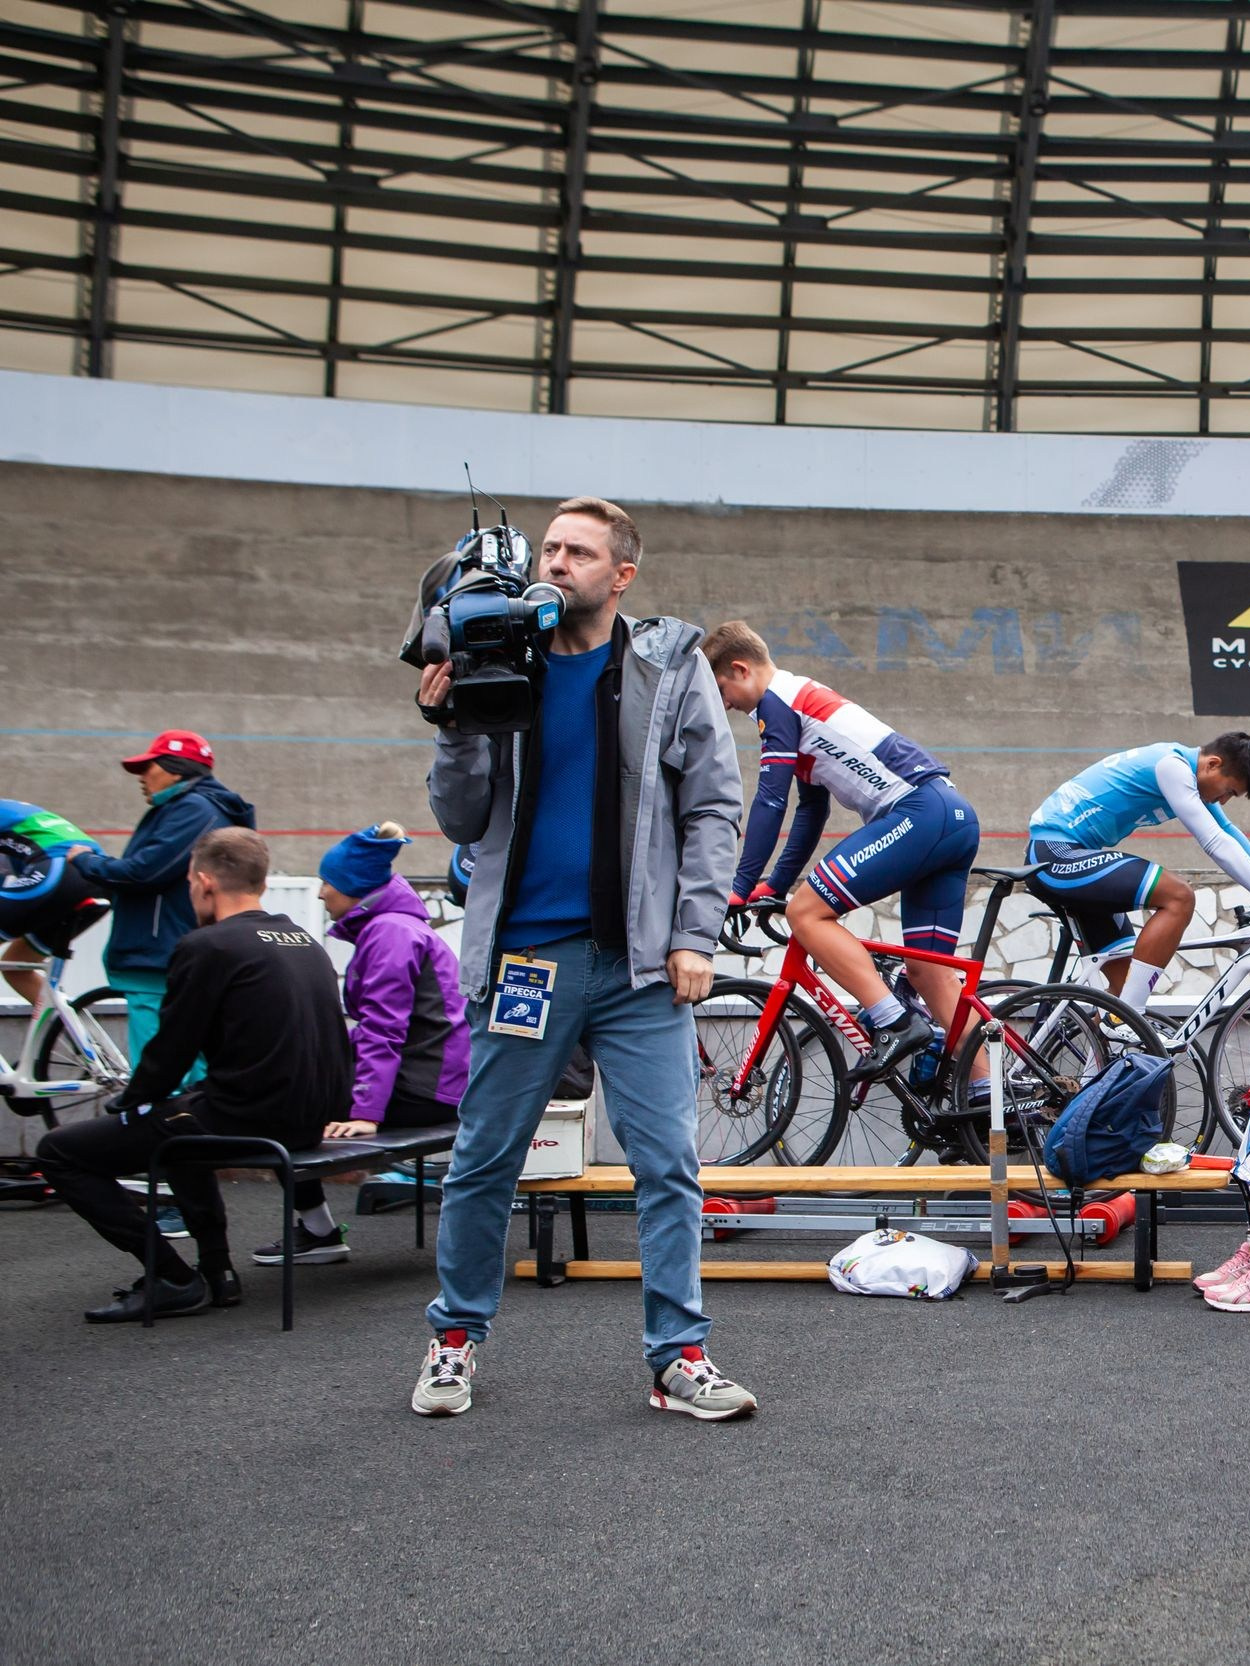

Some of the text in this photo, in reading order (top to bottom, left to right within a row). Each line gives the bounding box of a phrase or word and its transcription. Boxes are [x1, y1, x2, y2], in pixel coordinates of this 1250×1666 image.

[810, 736, 891, 791] TULA REGION
[1067, 804, 1104, 829] LOOK
[849, 816, 915, 868] VOZROZDENIE
[1051, 851, 1124, 875] UZBEKISTAN
[256, 929, 313, 944] STAFF
[503, 985, 543, 999] ПРЕССА
[1176, 979, 1229, 1042] OTT
[734, 1025, 761, 1082] SPECIALIZED
